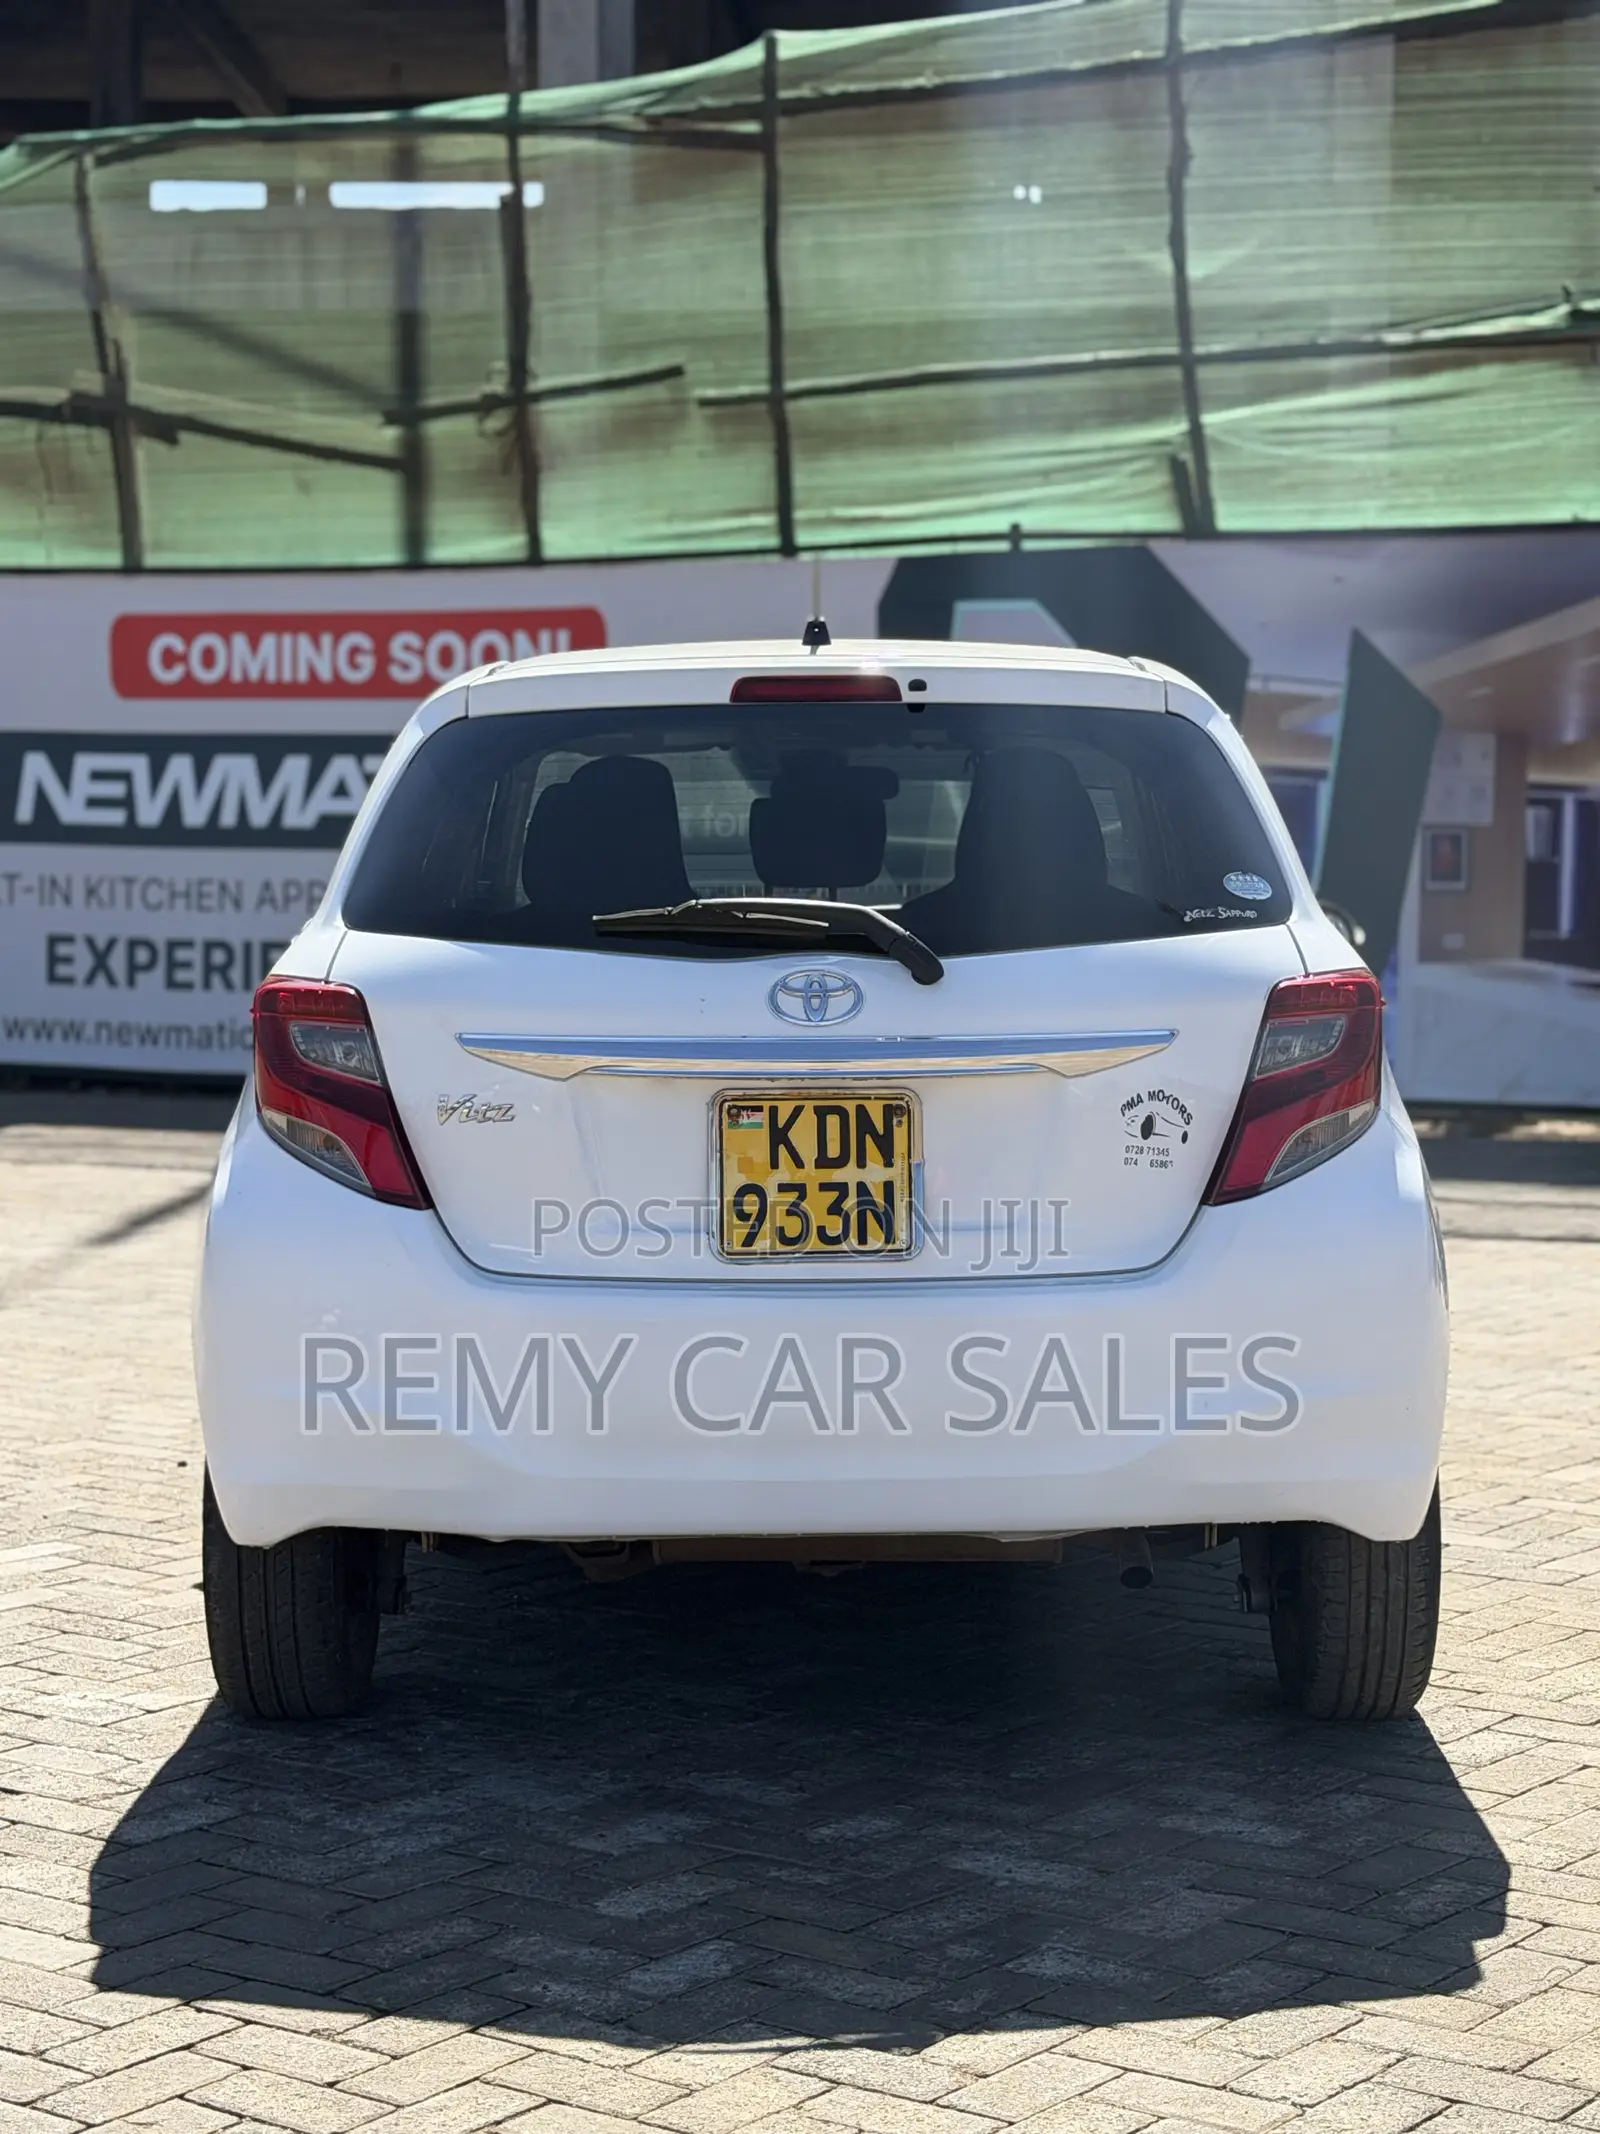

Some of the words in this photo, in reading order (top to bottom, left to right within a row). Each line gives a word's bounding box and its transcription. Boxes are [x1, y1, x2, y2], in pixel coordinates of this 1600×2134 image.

[147, 631, 376, 685] COMING
[84, 873, 244, 914] KITCHEN
[437, 1093, 516, 1126] Vitz
[1120, 1093, 1144, 1117] PMA
[1147, 1089, 1193, 1126] MOTORS
[768, 1104, 894, 1170] KDN
[1125, 1145, 1144, 1155] 0728
[732, 1181, 897, 1247] 933N
